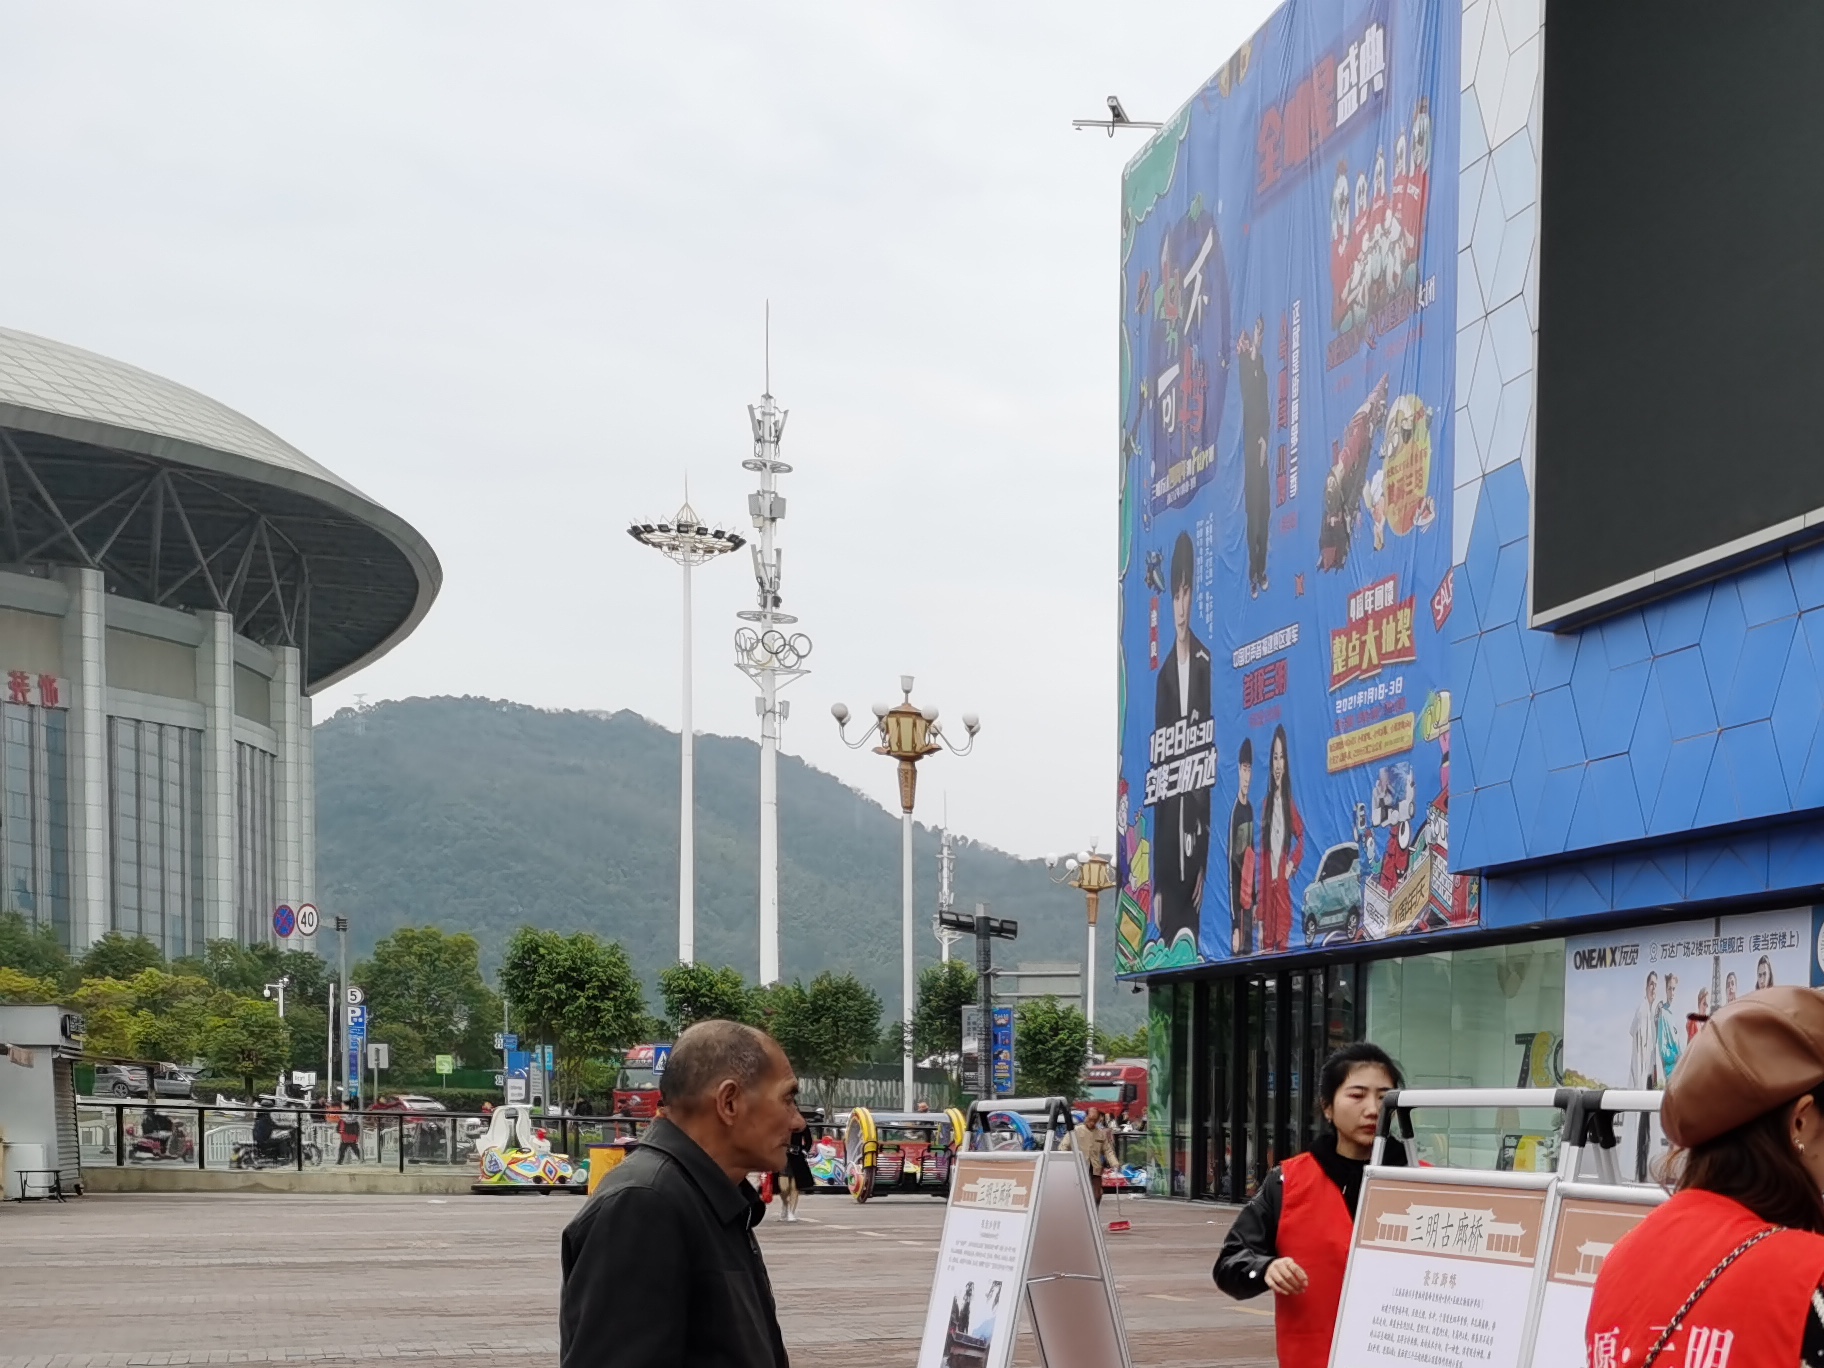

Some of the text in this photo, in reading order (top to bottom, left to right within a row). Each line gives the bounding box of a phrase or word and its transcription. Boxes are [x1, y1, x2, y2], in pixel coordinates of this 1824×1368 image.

[1332, 608, 1411, 676] 整点大抽奖
[1145, 747, 1217, 806] 空降三明万达
[300, 911, 315, 928] 40
[1411, 1212, 1484, 1255] 三明古廊桥
